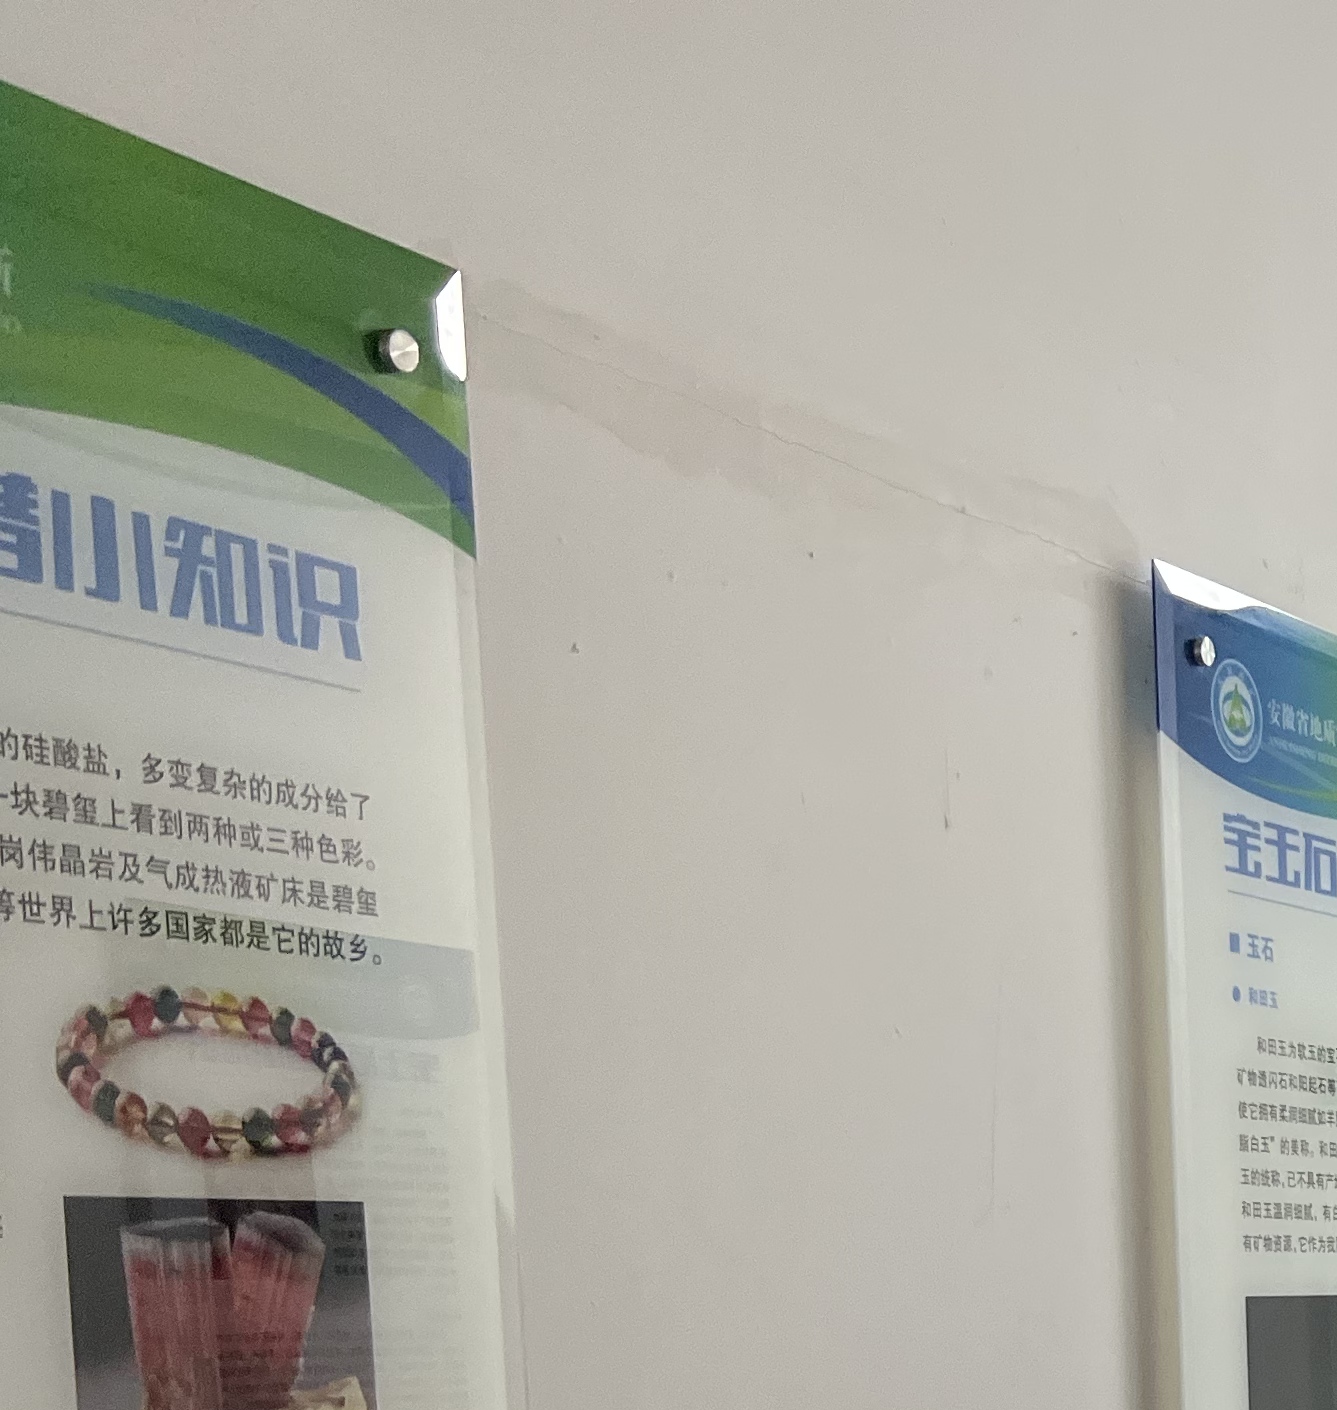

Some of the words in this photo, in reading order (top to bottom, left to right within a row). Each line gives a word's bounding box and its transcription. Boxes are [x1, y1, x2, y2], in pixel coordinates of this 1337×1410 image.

[0, 782, 376, 871] 块碧玺上看到两种或三种色彩。
[0, 834, 379, 917] 岗伟晶岩及气成热液矿床是碧玺
[1246, 933, 1274, 963] 玉石
